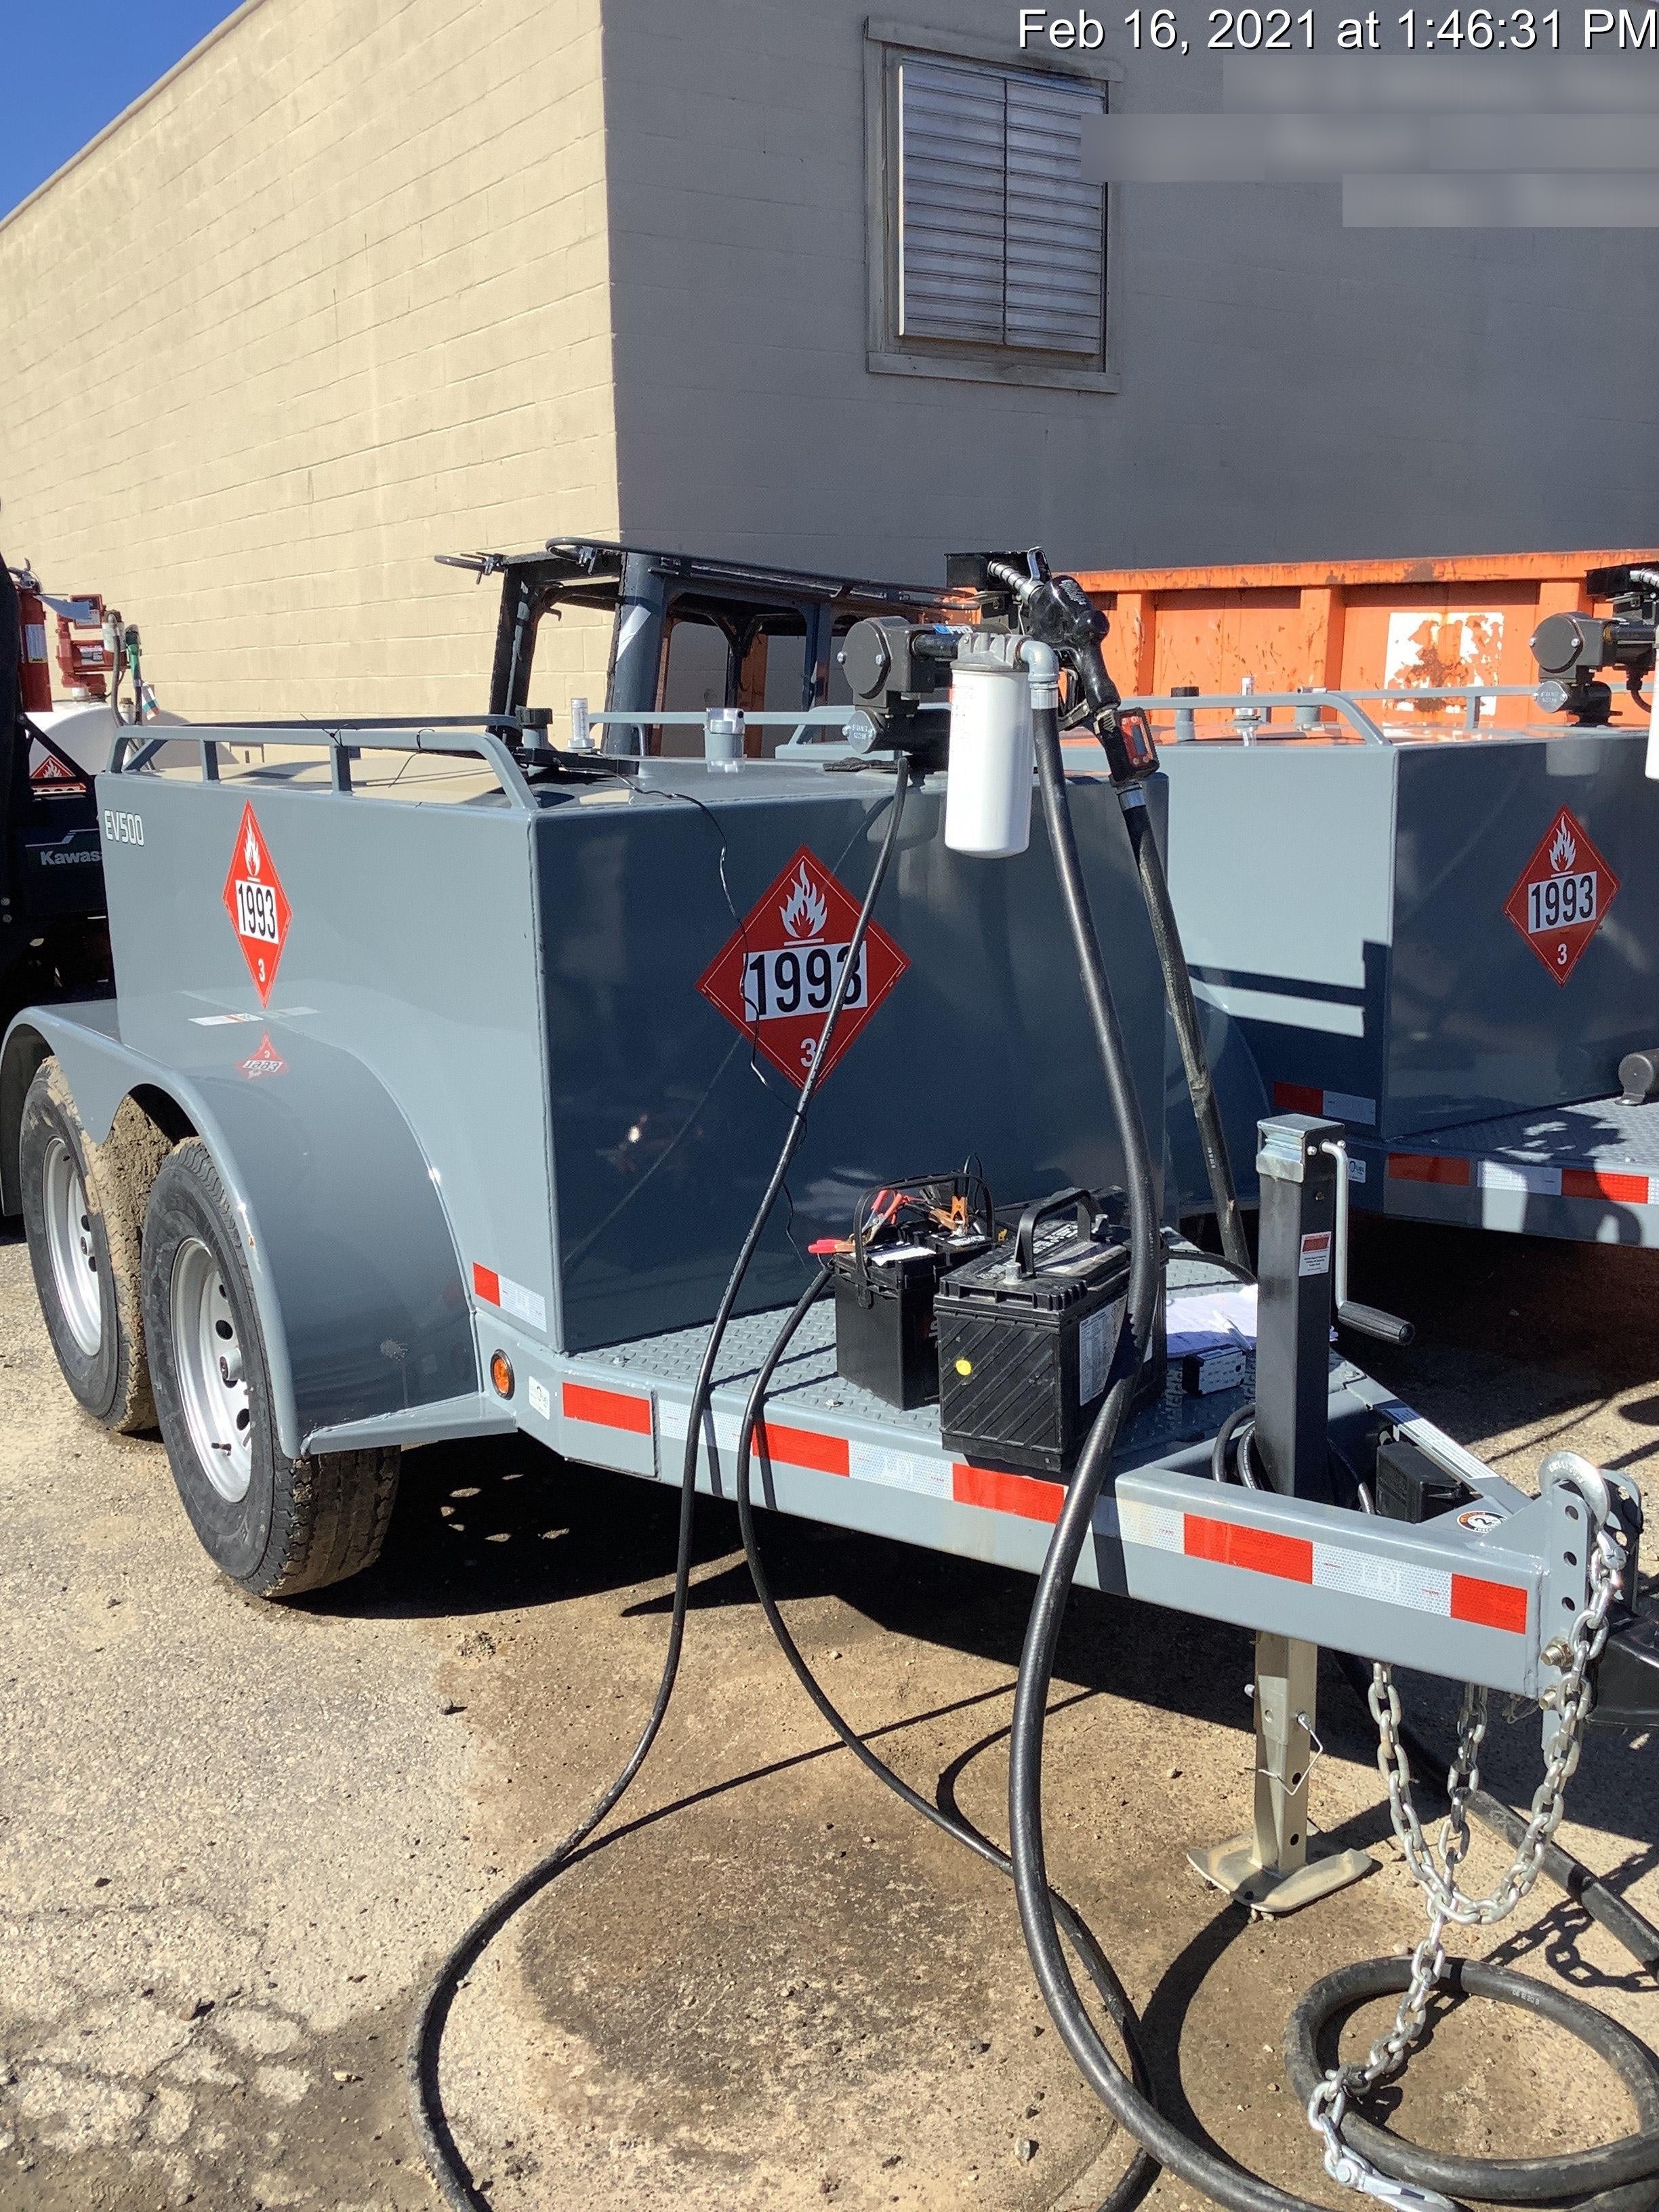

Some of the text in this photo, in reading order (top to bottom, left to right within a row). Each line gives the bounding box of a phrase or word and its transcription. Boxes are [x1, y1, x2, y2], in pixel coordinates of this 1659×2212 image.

[104, 809, 145, 846] EV500
[40, 851, 102, 865] Kawas
[238, 883, 276, 939] 1993
[1531, 875, 1593, 929] 1993
[258, 958, 266, 983] 3
[1557, 943, 1568, 965] 3
[749, 945, 863, 1015] 1993
[800, 1038, 817, 1068] 3
